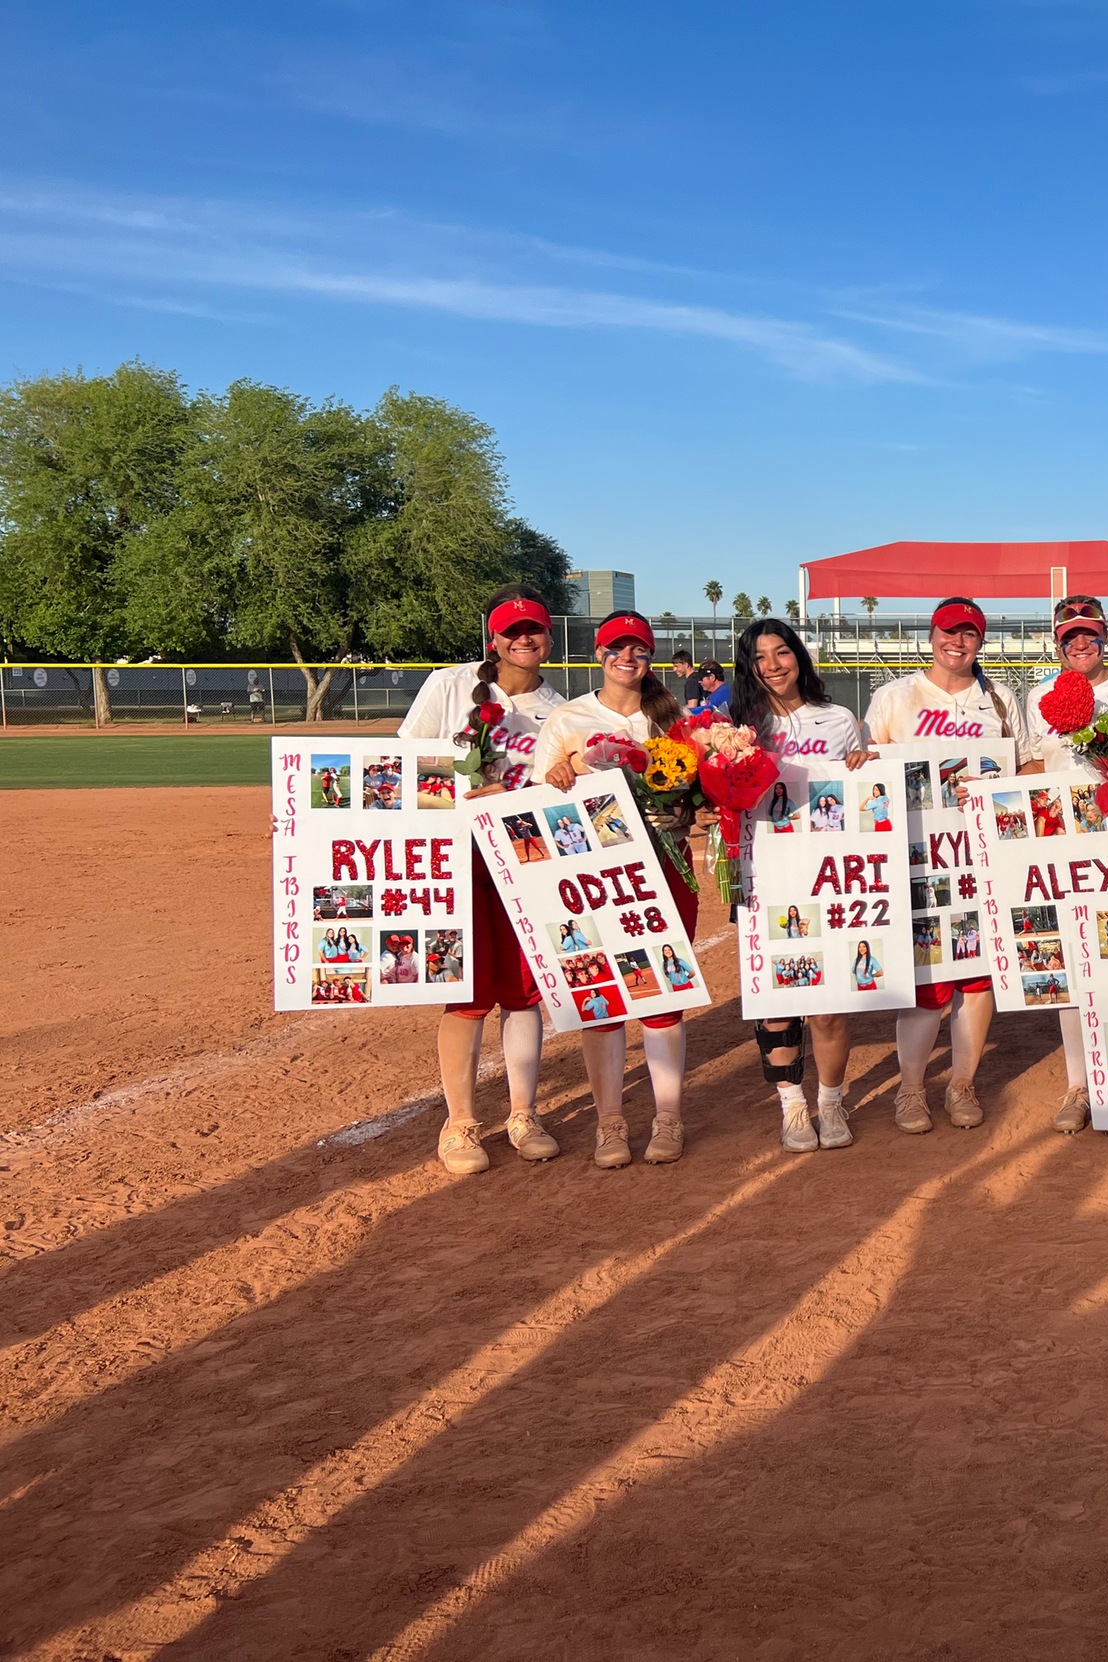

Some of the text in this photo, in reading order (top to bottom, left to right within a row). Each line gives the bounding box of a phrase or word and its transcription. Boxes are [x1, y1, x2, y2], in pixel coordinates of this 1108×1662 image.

[478, 724, 537, 755] esa
[914, 707, 983, 739] Mesa
[279, 754, 301, 836] MESA
[474, 812, 514, 885] MESA
[740, 808, 755, 861] ESA
[970, 795, 989, 868] MESA
[332, 838, 454, 881] RYLEE
[811, 853, 890, 896] ARI
[381, 887, 455, 916] #44
[558, 861, 658, 914] ODIE
[619, 906, 669, 937] #8
[826, 898, 891, 929] #22
[1072, 905, 1092, 978] MESA
